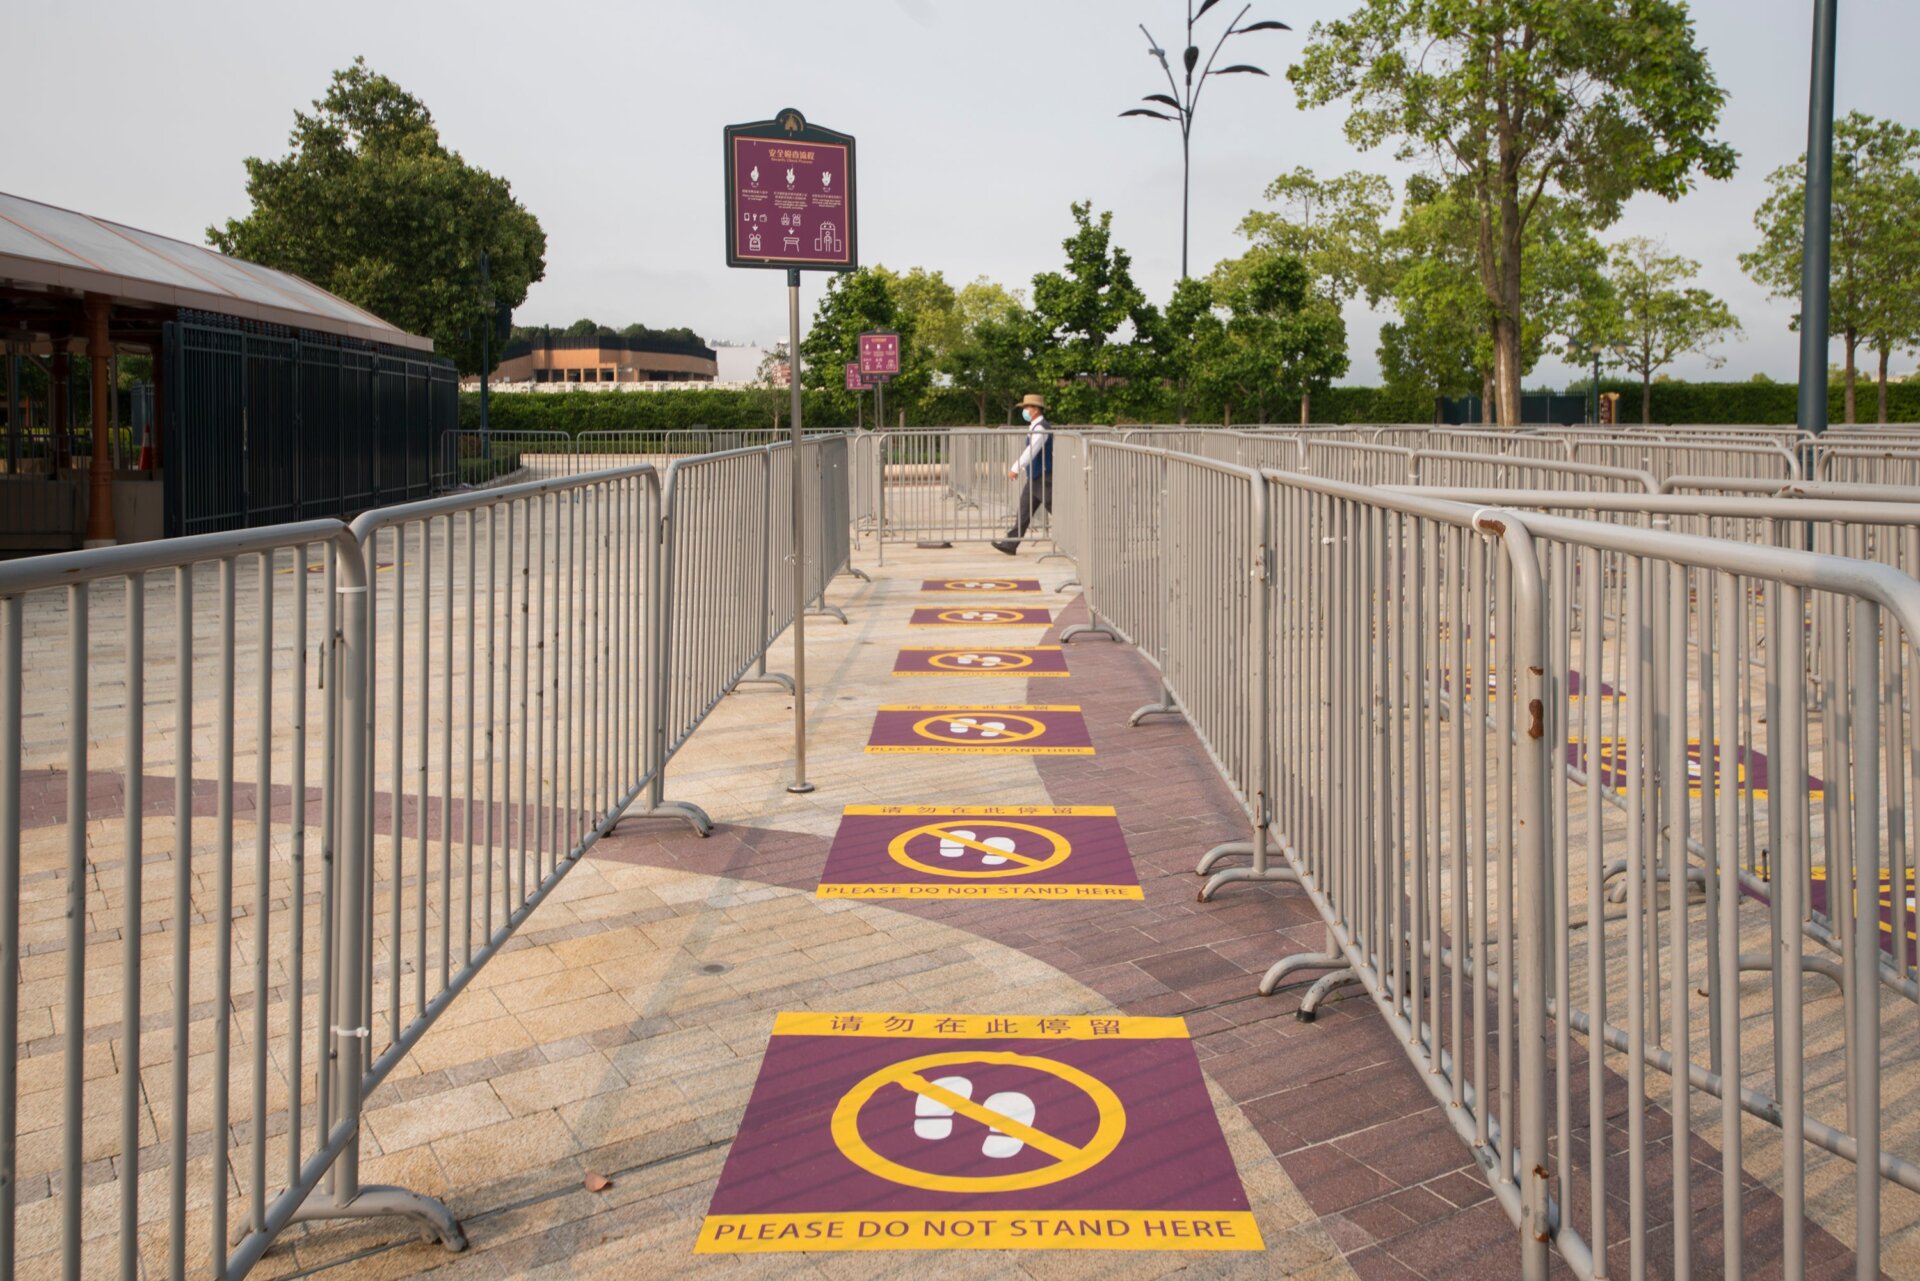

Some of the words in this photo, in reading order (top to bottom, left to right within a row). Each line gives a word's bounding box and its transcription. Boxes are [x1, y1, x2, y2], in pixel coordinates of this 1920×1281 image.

[826, 887, 901, 895] PLEASE
[909, 887, 940, 895] DO
[947, 887, 989, 895] NOT
[998, 887, 1069, 895] STAND
[830, 1014, 1122, 1037] 请勿在此停留
[713, 1220, 845, 1242] PLEASE
[858, 1220, 910, 1239] DO
[923, 1219, 998, 1238] NOT
[1010, 1219, 1130, 1238] STAND
[1143, 1219, 1236, 1239] HERE
